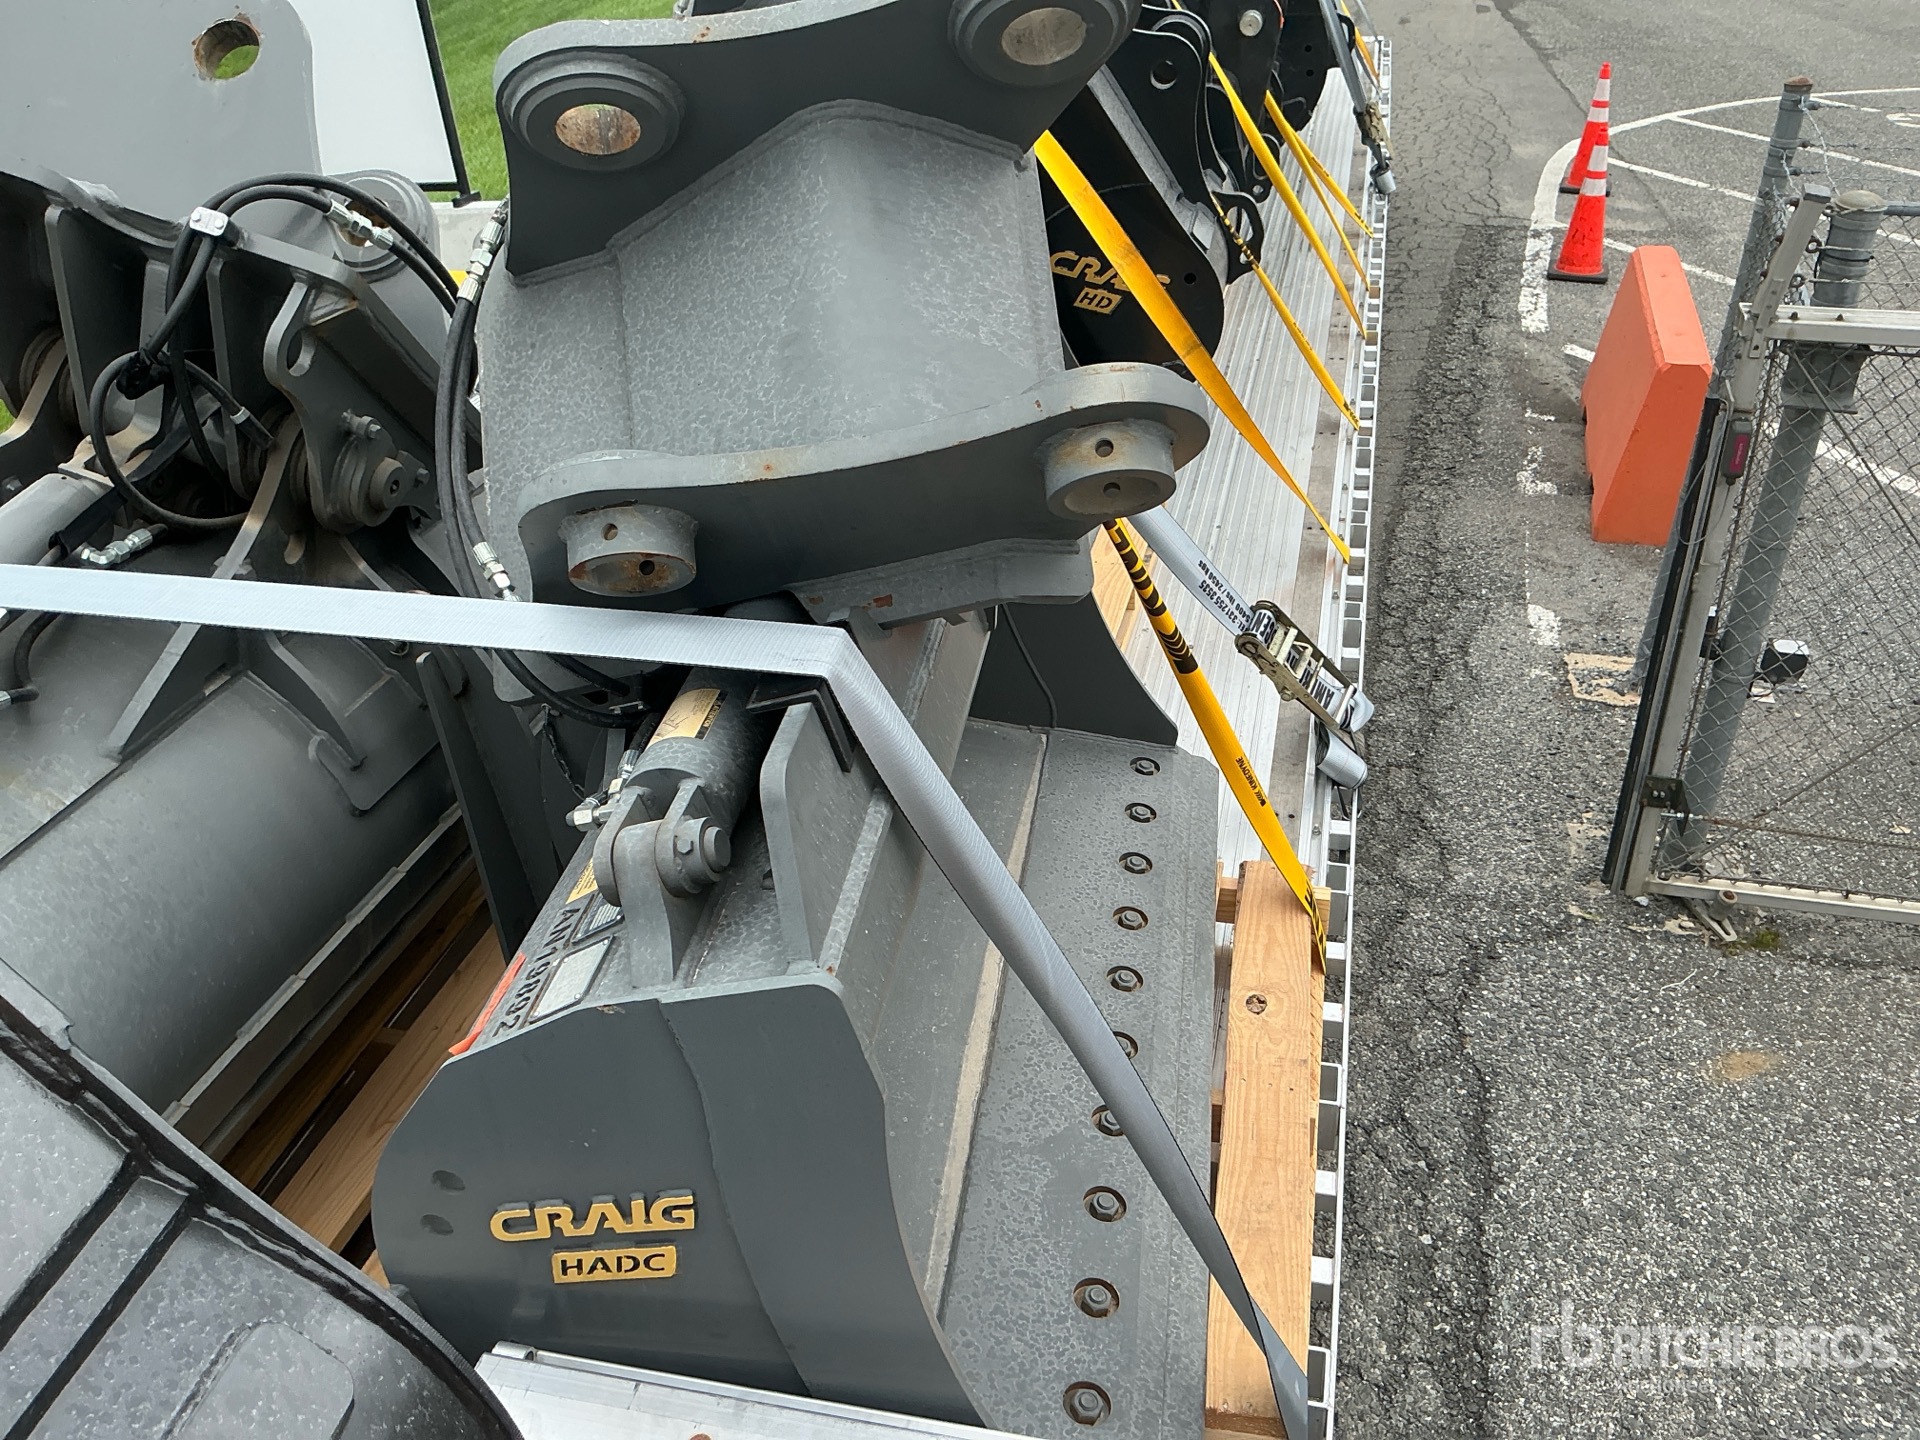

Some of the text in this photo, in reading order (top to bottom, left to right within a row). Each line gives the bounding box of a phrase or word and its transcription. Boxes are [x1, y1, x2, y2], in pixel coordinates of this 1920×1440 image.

[1078, 291, 1114, 310] HD
[1235, 756, 1258, 791] KINEDYNE
[490, 1194, 695, 1242] CRAIG
[560, 1253, 666, 1277] HADC
